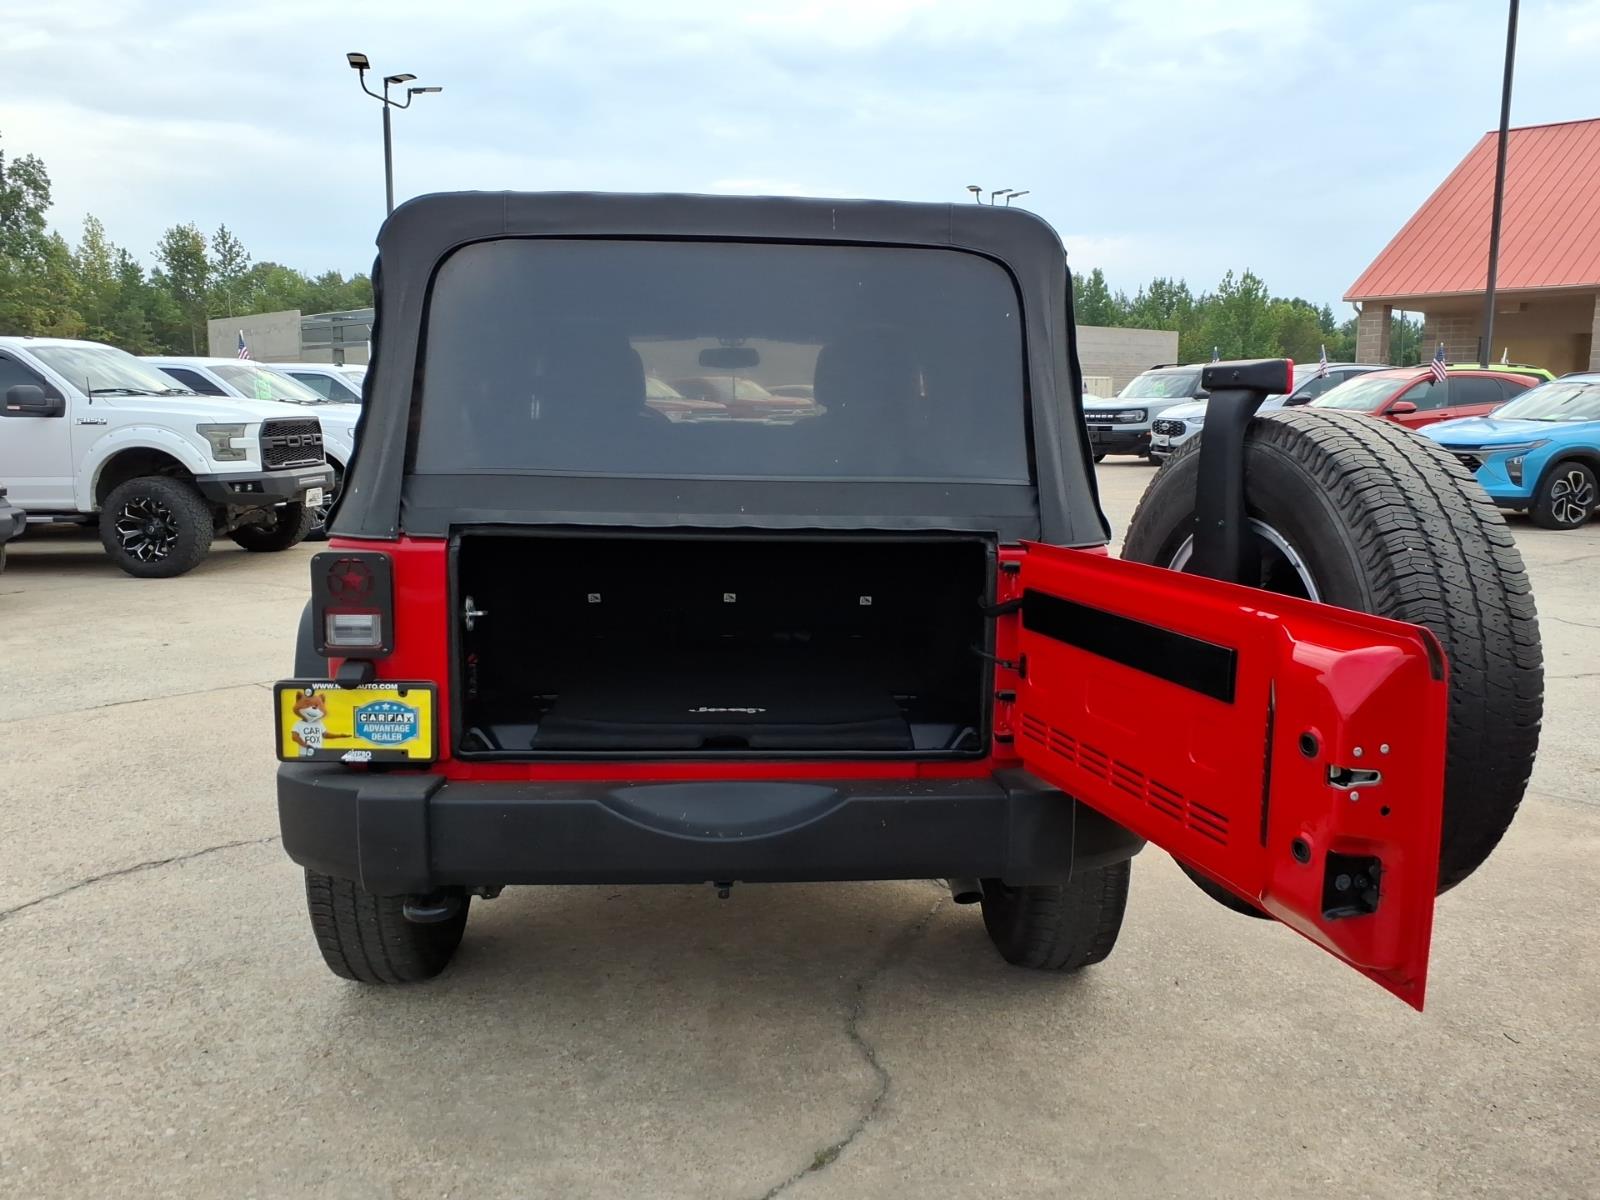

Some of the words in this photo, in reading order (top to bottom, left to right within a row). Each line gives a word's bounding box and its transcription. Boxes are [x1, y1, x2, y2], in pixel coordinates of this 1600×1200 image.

[265, 433, 323, 447] FORD
[360, 712, 414, 723] CARFAX
[303, 726, 321, 735] CAR
[363, 724, 410, 732] ADVANTAGE
[304, 735, 321, 744] FOX
[371, 733, 402, 741] DEALER
